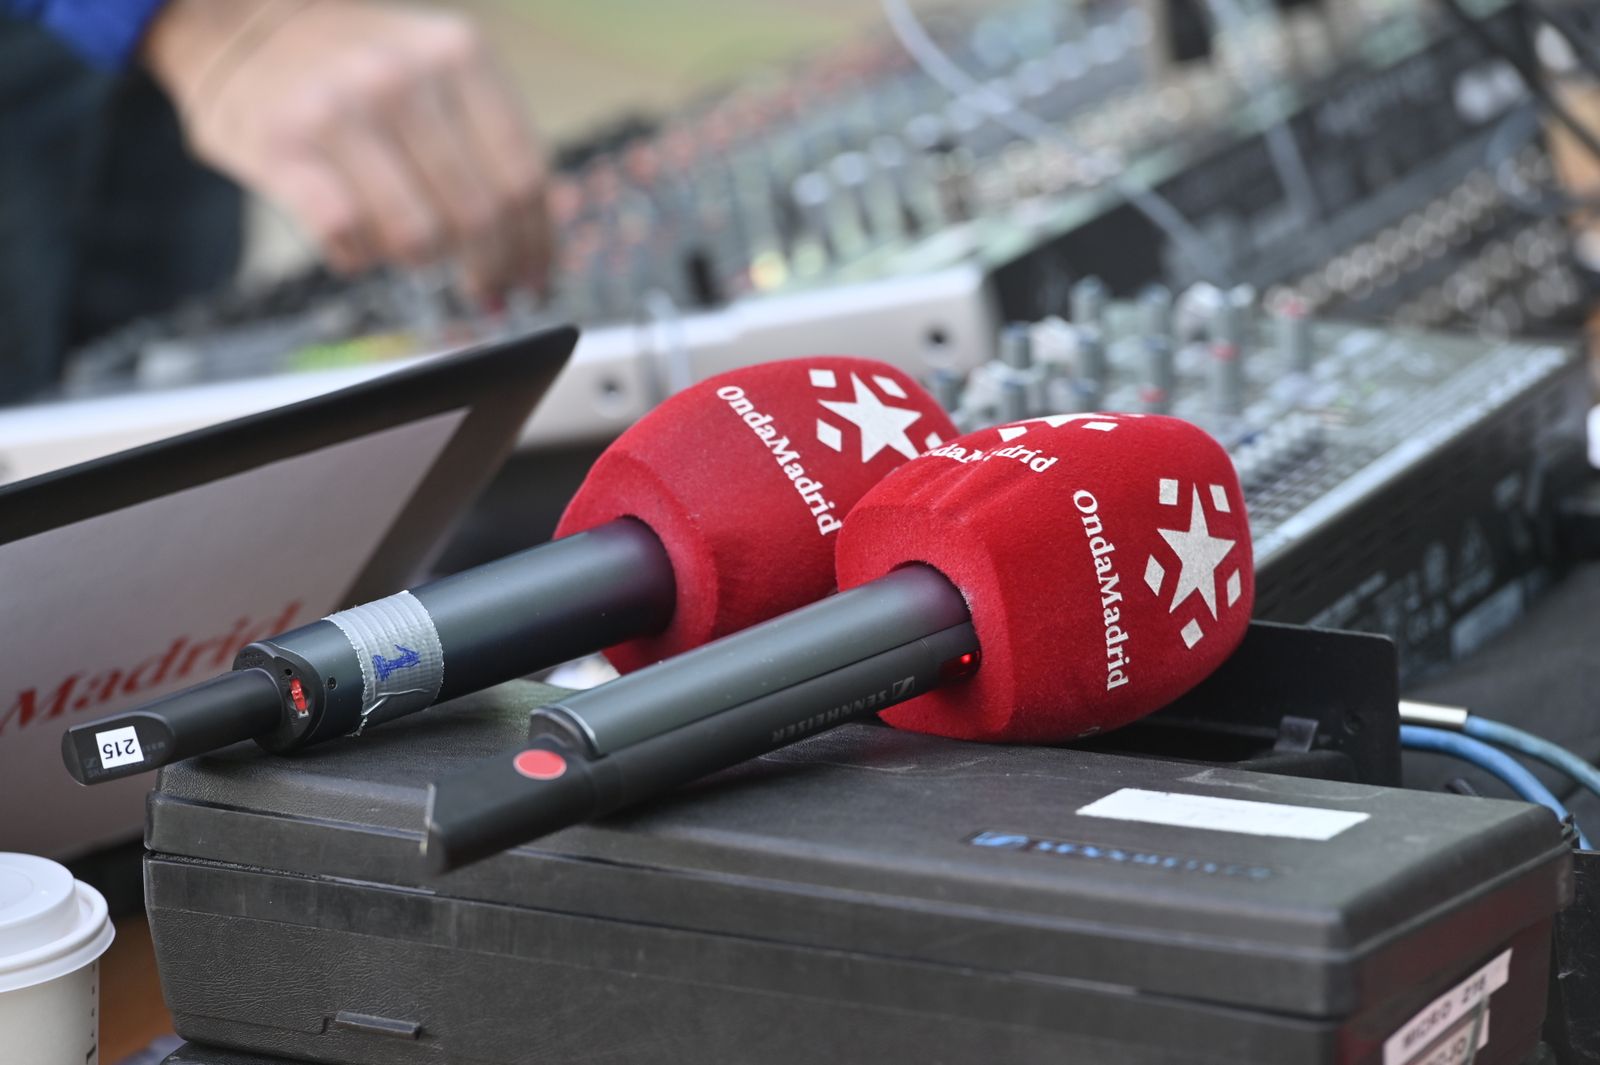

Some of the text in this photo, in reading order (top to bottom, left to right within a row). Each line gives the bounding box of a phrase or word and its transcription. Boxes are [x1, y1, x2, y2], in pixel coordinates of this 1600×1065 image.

[716, 385, 842, 536] OndaMadrid
[1073, 489, 1130, 691] OndaMadrid
[102, 738, 136, 760] 215
[772, 690, 887, 743] SENNHEISER
